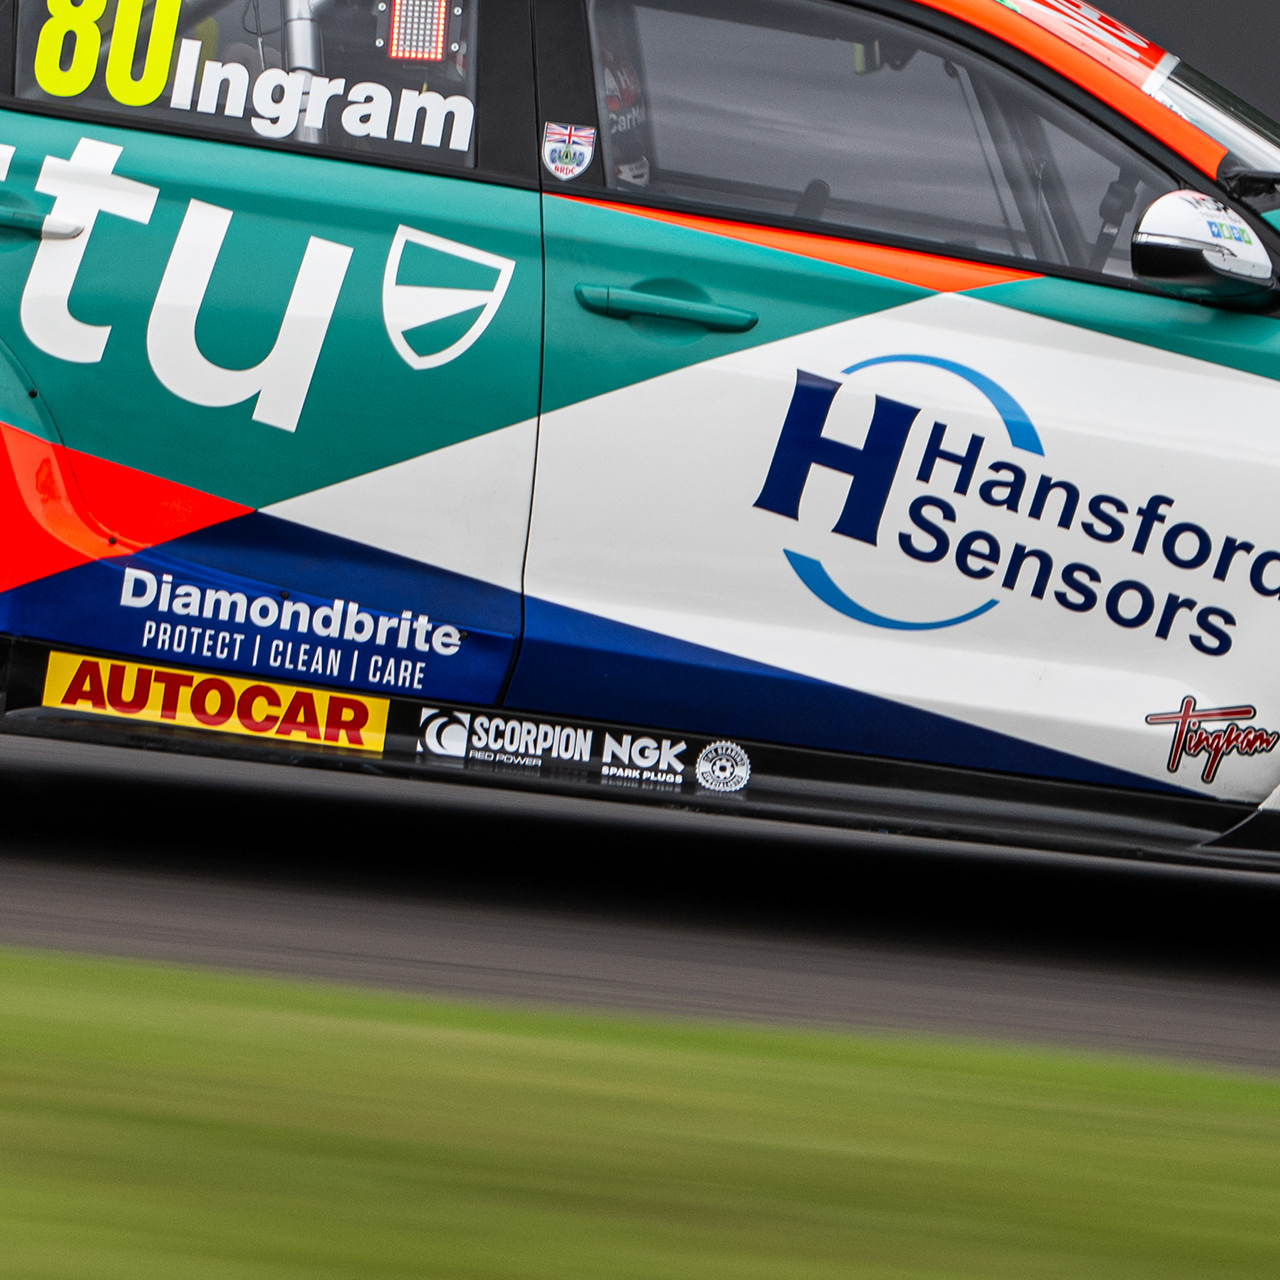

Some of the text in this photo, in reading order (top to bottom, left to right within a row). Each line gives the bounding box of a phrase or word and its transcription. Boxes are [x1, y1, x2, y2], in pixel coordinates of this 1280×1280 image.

[170, 37, 475, 153] Ingram
[898, 495, 1237, 657] Sensors
[120, 567, 461, 656] Diamondbrite
[142, 620, 426, 690] PROTECT CLEAN CARE
[60, 659, 370, 746] AUTOCAR
[469, 750, 541, 767] RED POWER
[471, 715, 594, 762] SCORPION
[602, 731, 687, 773] NGK
[602, 765, 683, 784] SPARK PLUGS
